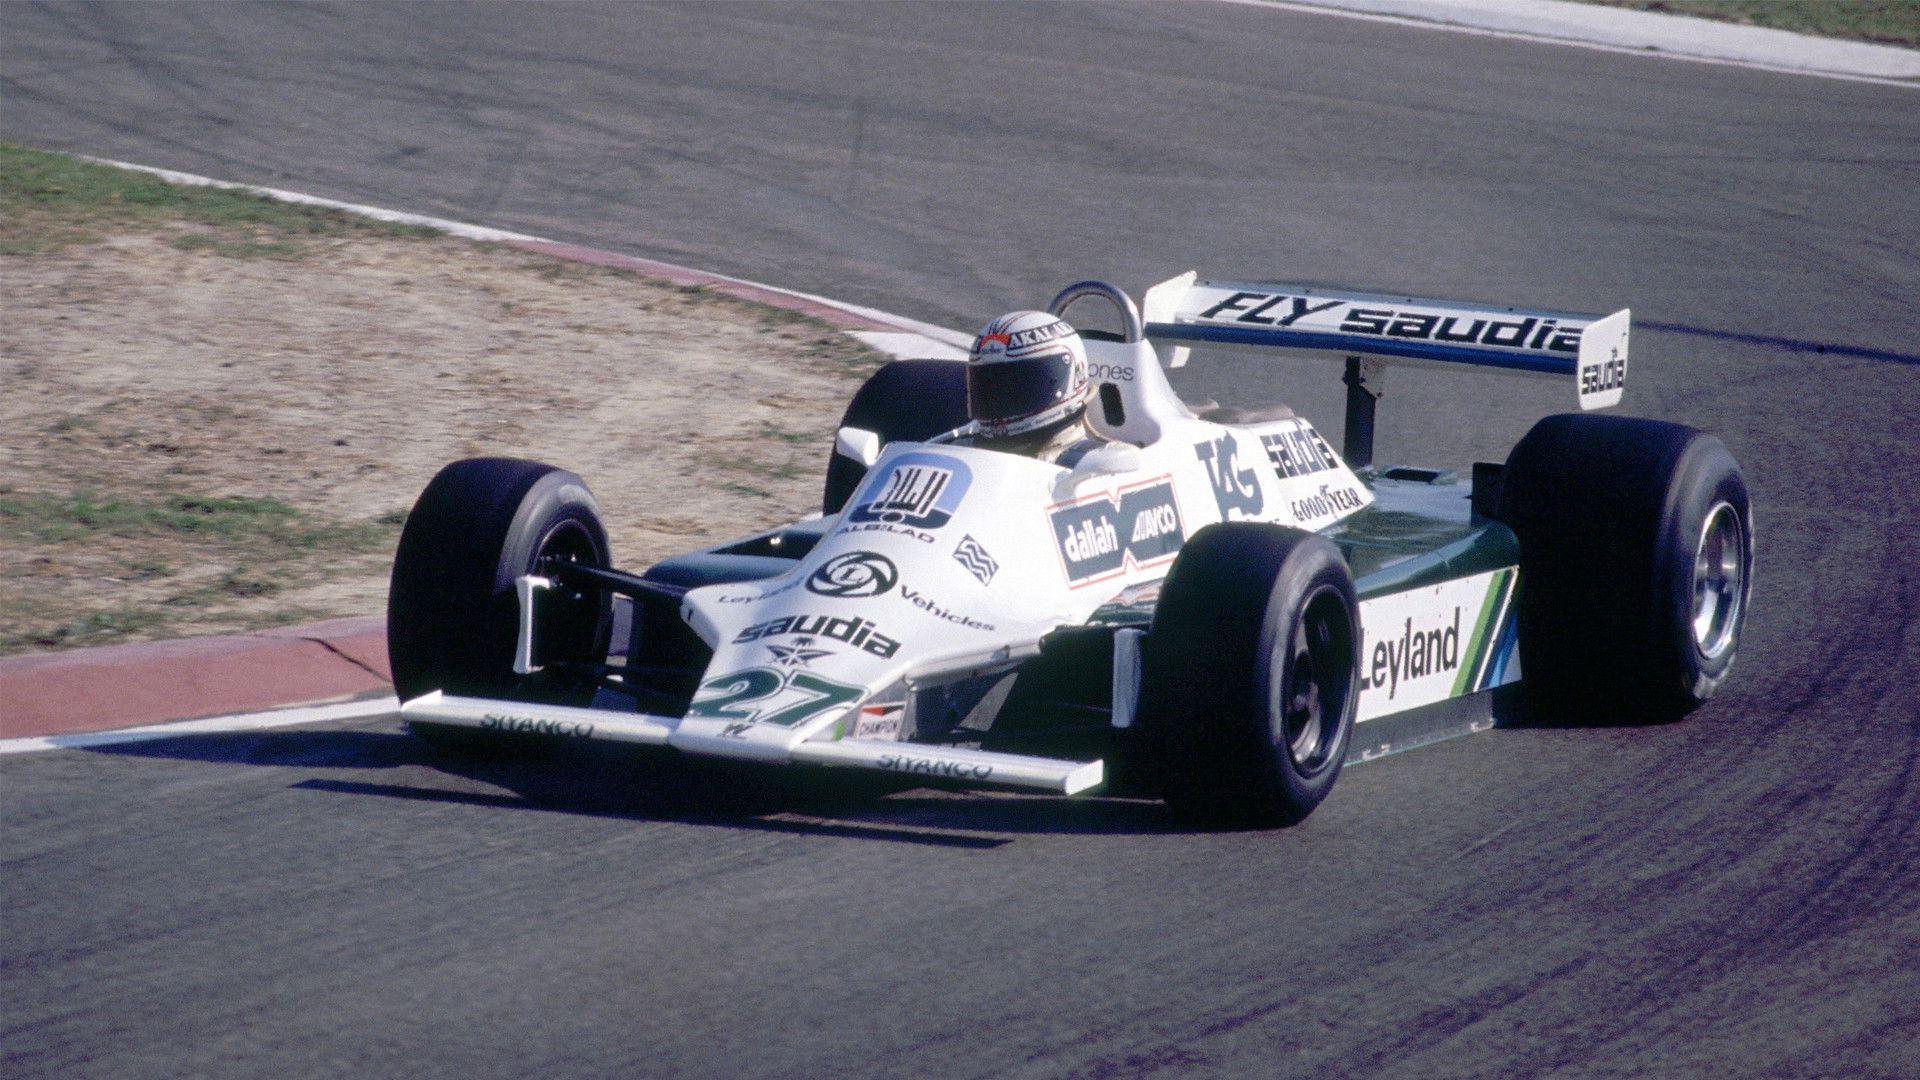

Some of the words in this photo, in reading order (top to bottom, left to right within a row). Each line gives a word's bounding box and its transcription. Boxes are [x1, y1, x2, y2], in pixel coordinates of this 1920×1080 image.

[1200, 292, 1343, 326] FLY
[1340, 307, 1584, 353] saudia
[1087, 361, 1135, 382] ones
[1193, 430, 1264, 522] TAG
[1291, 486, 1363, 521] GOODYEAR
[1064, 515, 1119, 562] dallah
[901, 584, 995, 631] Vehicles
[731, 614, 902, 660] saudia
[691, 667, 869, 728] 27
